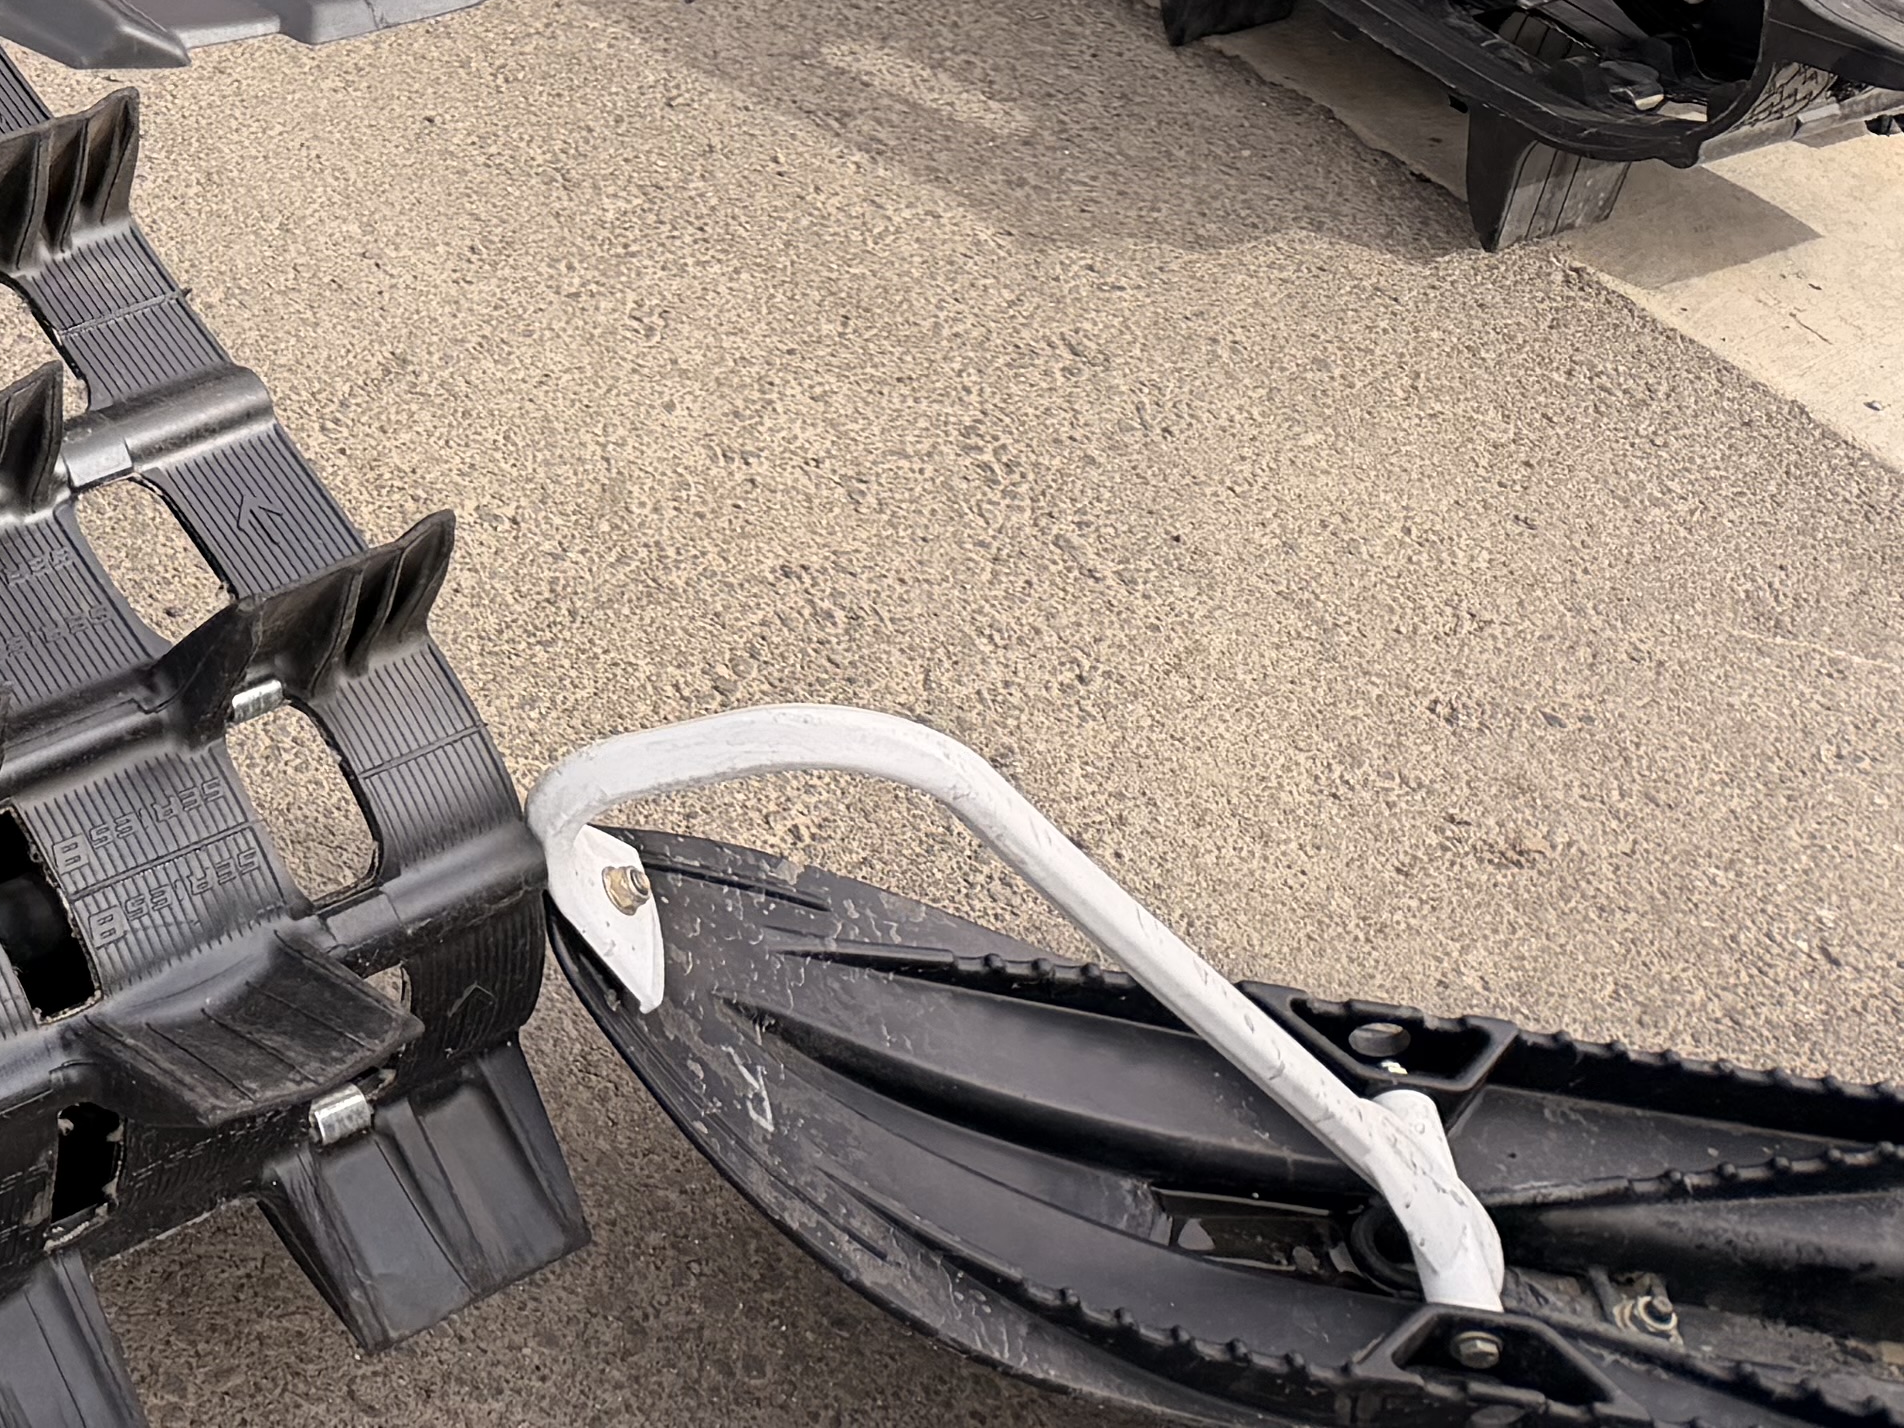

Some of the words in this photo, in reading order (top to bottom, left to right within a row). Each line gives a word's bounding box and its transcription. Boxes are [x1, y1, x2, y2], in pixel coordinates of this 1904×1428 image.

[89, 778, 227, 850] SERIES
[123, 848, 261, 920] SERIES
[89, 905, 128, 950] 8
